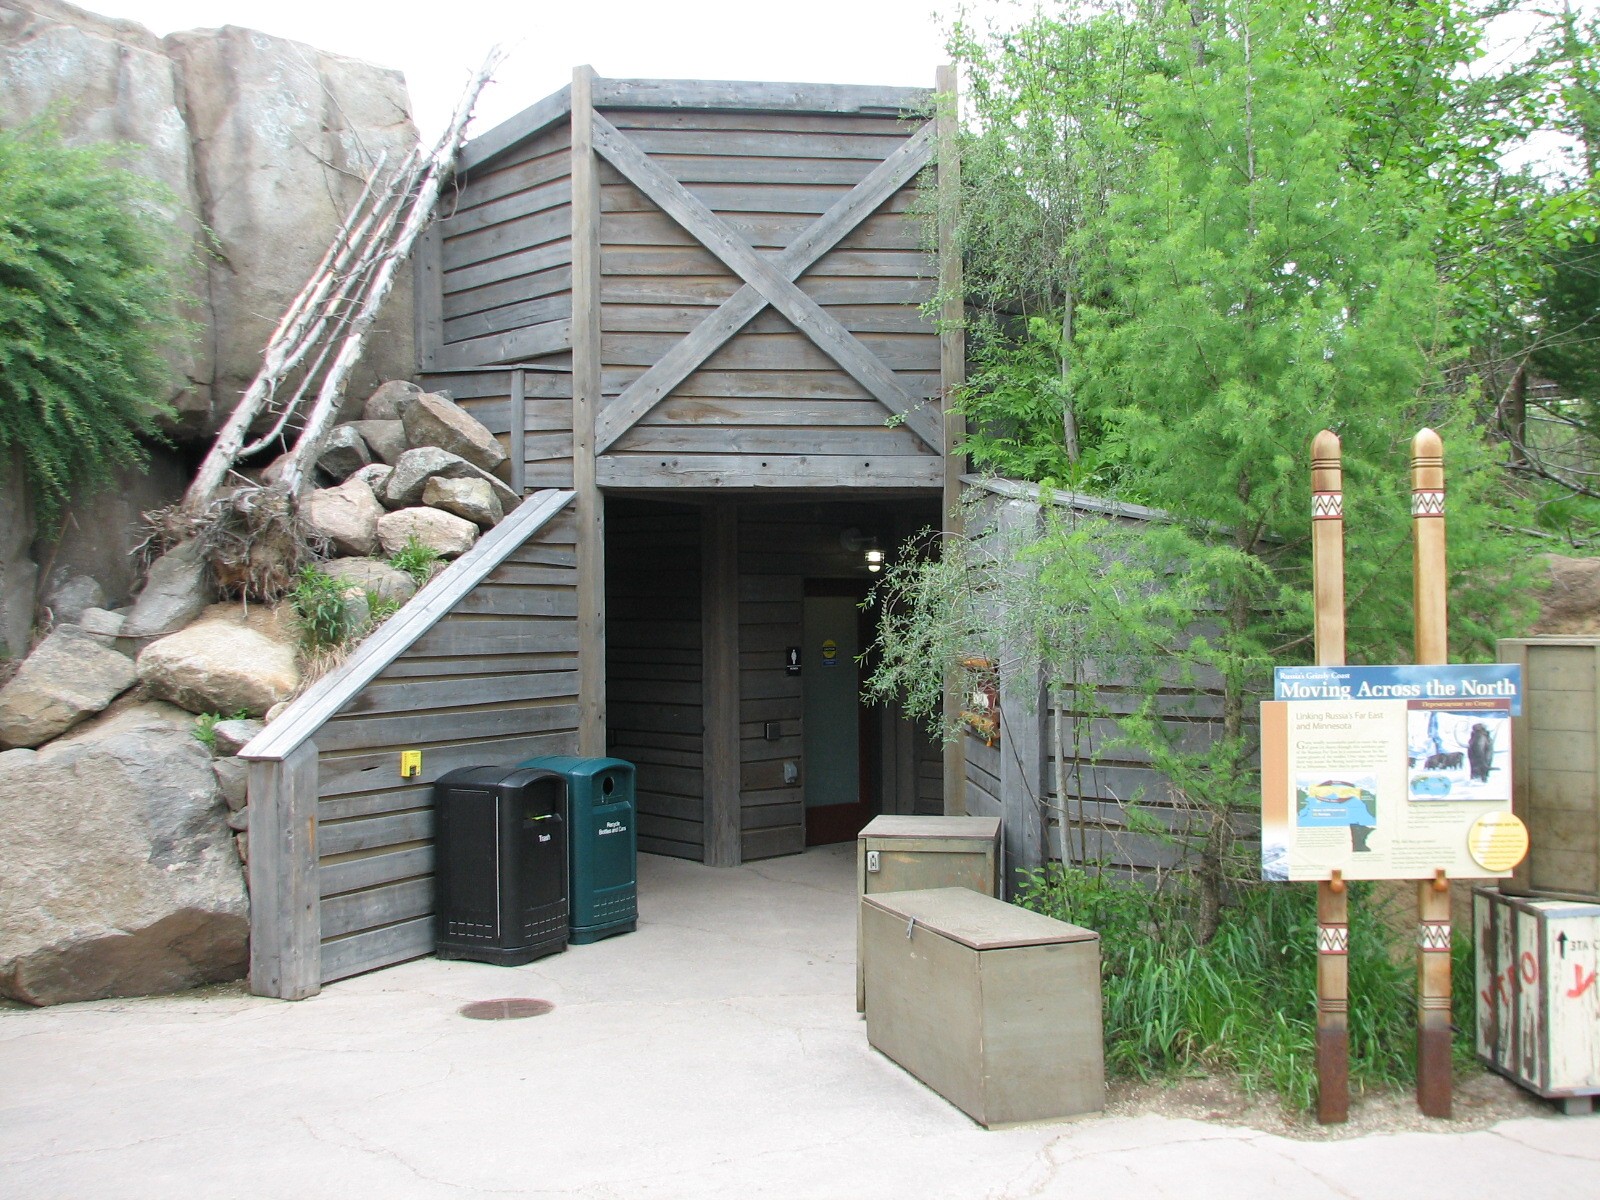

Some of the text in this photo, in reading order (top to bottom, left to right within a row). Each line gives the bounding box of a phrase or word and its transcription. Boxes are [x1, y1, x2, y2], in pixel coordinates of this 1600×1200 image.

[1306, 672, 1329, 680] Grizzly
[1280, 678, 1517, 700] Moving Across the North
[1296, 712, 1323, 721] Linking
[1325, 712, 1353, 720] Russia's
[539, 834, 551, 842] Trash
